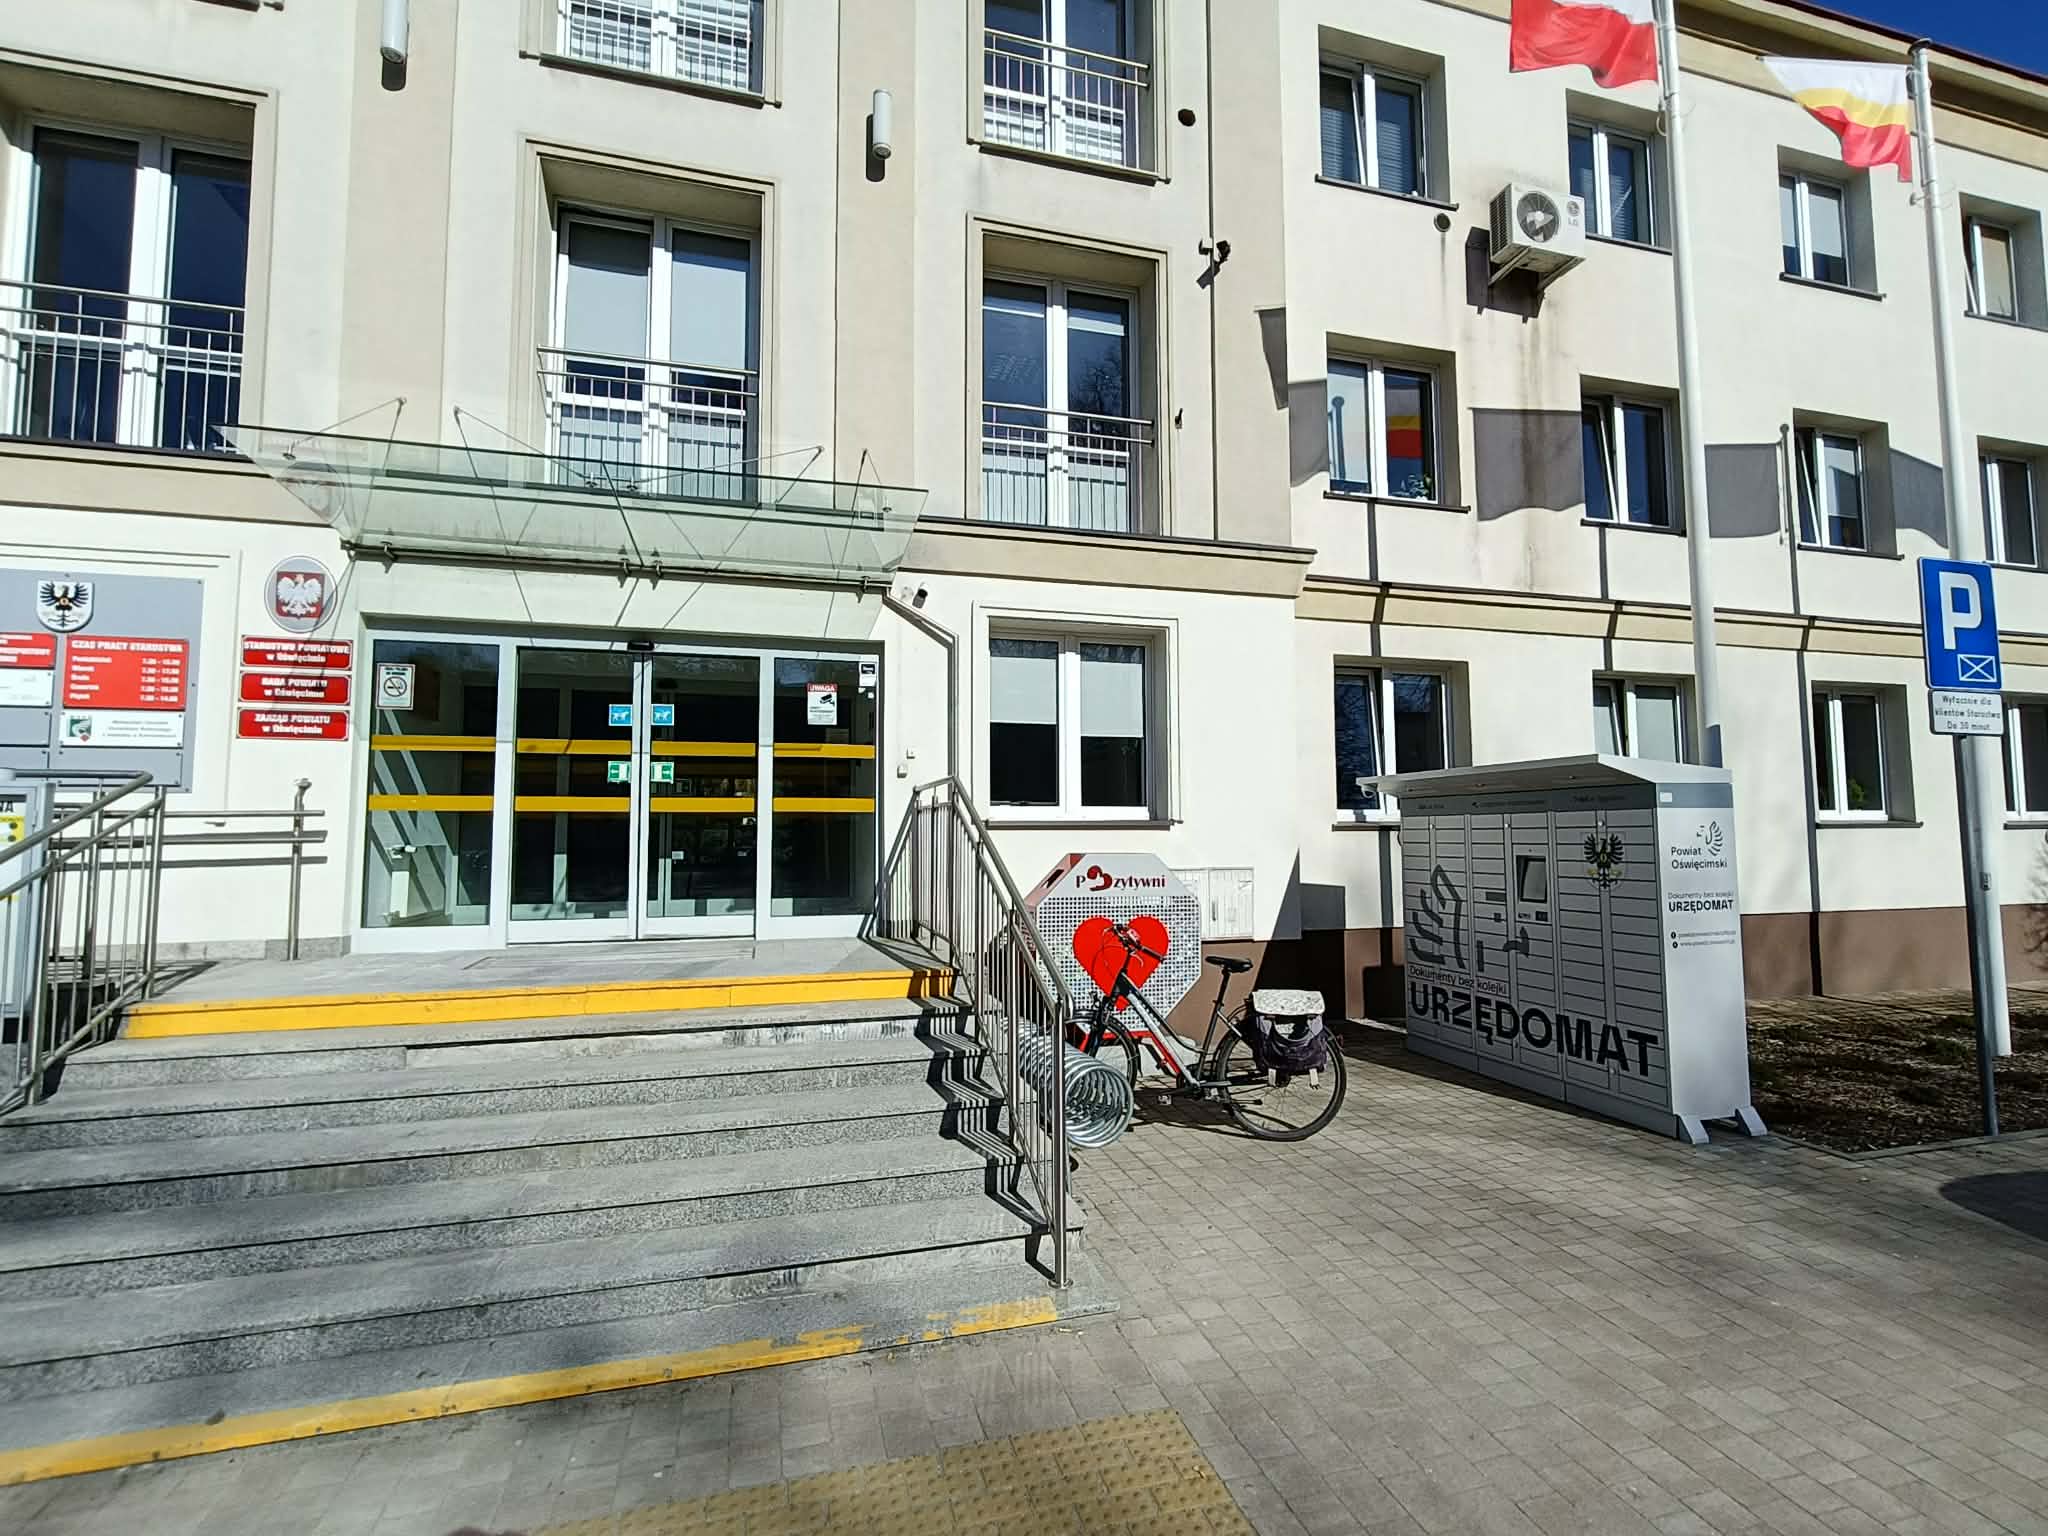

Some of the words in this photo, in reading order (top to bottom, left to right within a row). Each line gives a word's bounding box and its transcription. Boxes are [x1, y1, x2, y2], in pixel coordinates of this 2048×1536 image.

[1939, 571, 1982, 650] P
[290, 715, 331, 725] POWIATU
[1671, 846, 1702, 857] Powiat
[1671, 858, 1728, 871] Oświęcimski
[1668, 899, 1733, 914] URZĘDOMAT
[1409, 965, 1456, 985] Dokumenty
[1458, 976, 1475, 988] bez
[1477, 979, 1507, 995] kolejki
[1410, 981, 1658, 1077] URZĘDOMAT
